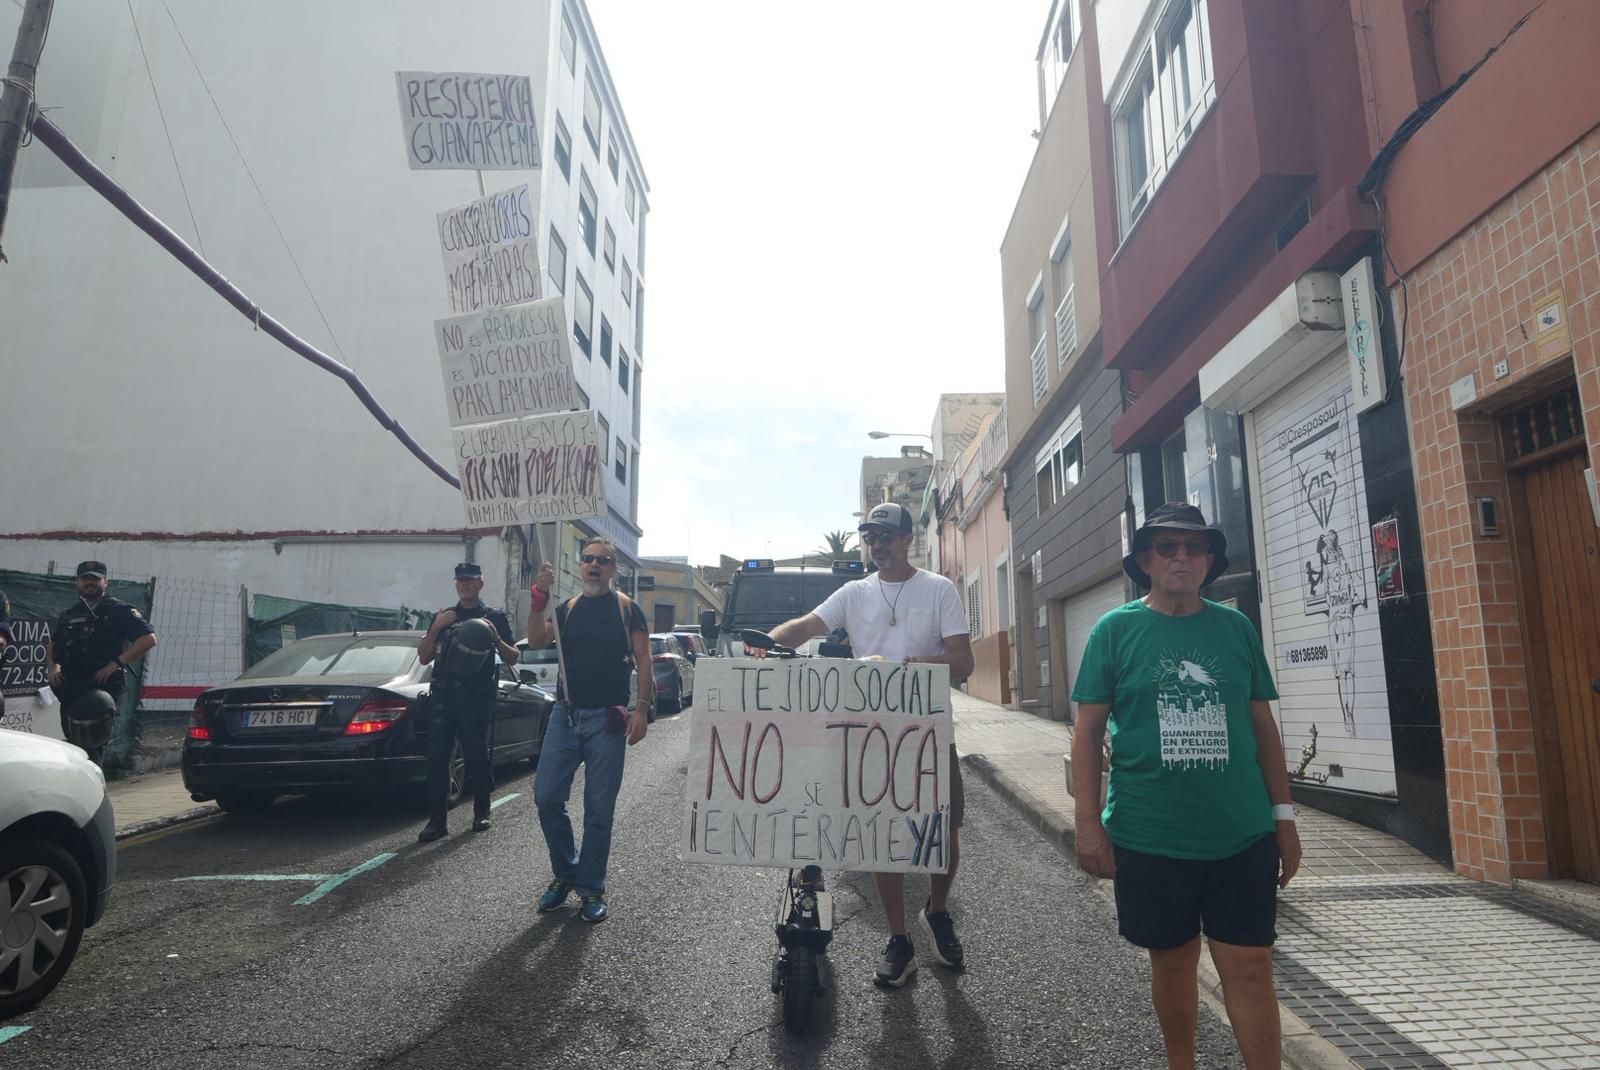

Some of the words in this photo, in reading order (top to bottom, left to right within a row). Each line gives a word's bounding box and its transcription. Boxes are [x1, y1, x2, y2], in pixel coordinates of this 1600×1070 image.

[407, 75, 535, 123] RESISTENCIA
[411, 120, 539, 168] GUANARTEME
[442, 324, 464, 352] NO
[469, 337, 482, 347] ES
[483, 305, 559, 344] PROGRESO
[452, 371, 464, 382] ES
[469, 338, 566, 378] DICTADURA
[452, 366, 576, 419] PARLAMENTARIA
[707, 688, 725, 712] EL
[732, 663, 840, 712] TEJIDO
[845, 665, 945, 716] SOCIAL
[252, 710, 283, 725] 7416
[288, 710, 313, 723] HGY
[1162, 730, 1227, 738] GUANARTEME
[1163, 738, 1178, 746] EN
[1181, 738, 1227, 747] PELIGRO
[1163, 747, 1175, 755] DE
[1178, 746, 1228, 755] EXTINCIÓN
[706, 721, 784, 805] NO
[804, 782, 824, 807] SE
[826, 721, 939, 813] TOCA
